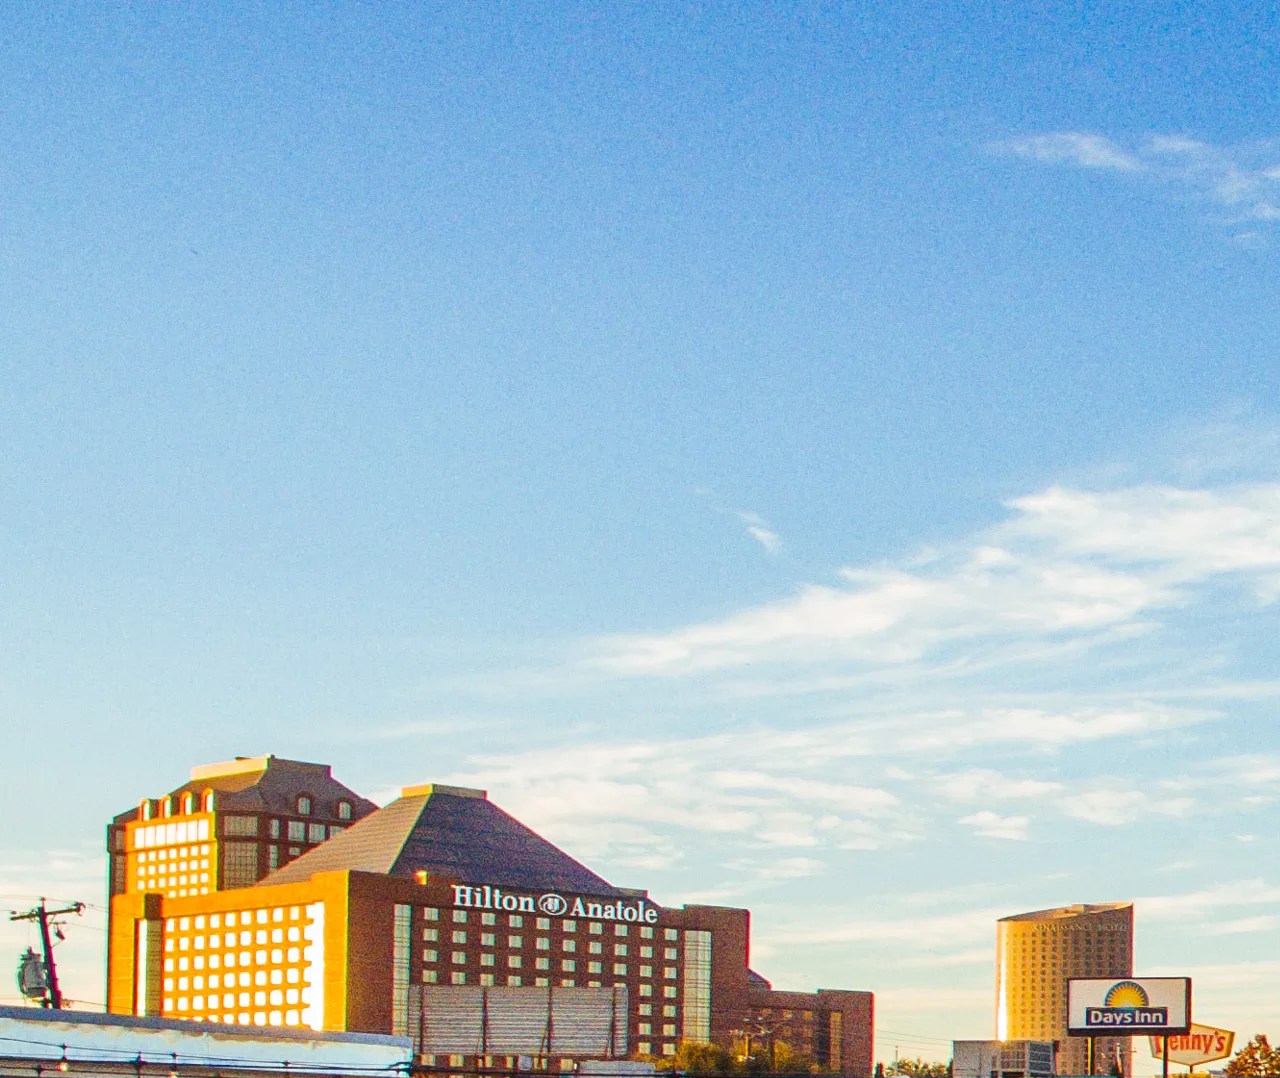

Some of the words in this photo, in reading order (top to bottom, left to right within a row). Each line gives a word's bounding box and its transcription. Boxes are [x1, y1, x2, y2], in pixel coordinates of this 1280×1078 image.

[453, 885, 536, 913] Hilton
[570, 896, 659, 924] Anatole
[1090, 1010, 1132, 1026] Days
[1135, 1009, 1164, 1024] Inn
[1153, 1030, 1226, 1055] enny's
